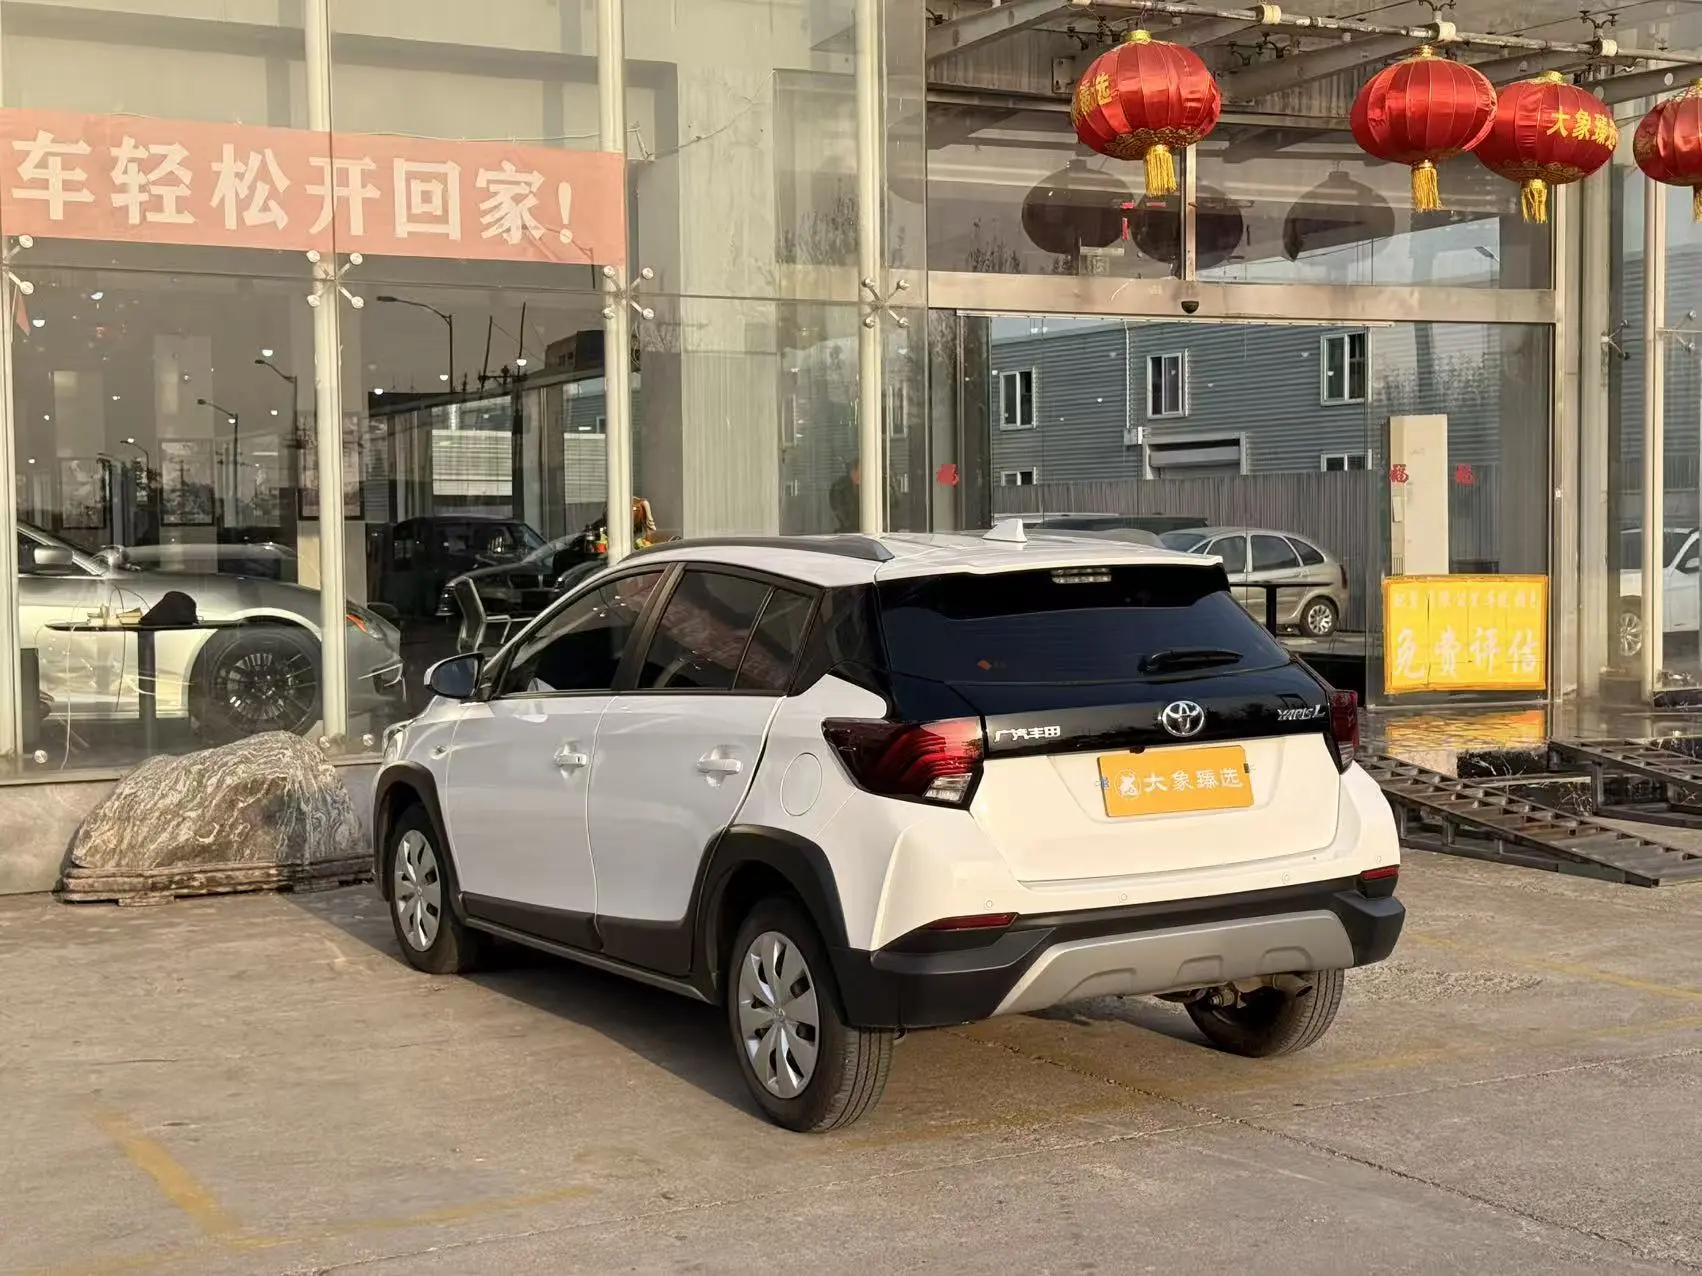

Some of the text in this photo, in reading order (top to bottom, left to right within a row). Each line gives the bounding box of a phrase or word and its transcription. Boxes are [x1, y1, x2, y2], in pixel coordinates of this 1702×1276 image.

[1394, 625, 1538, 679] 免费评估
[994, 725, 1061, 743] 广汽丰田
